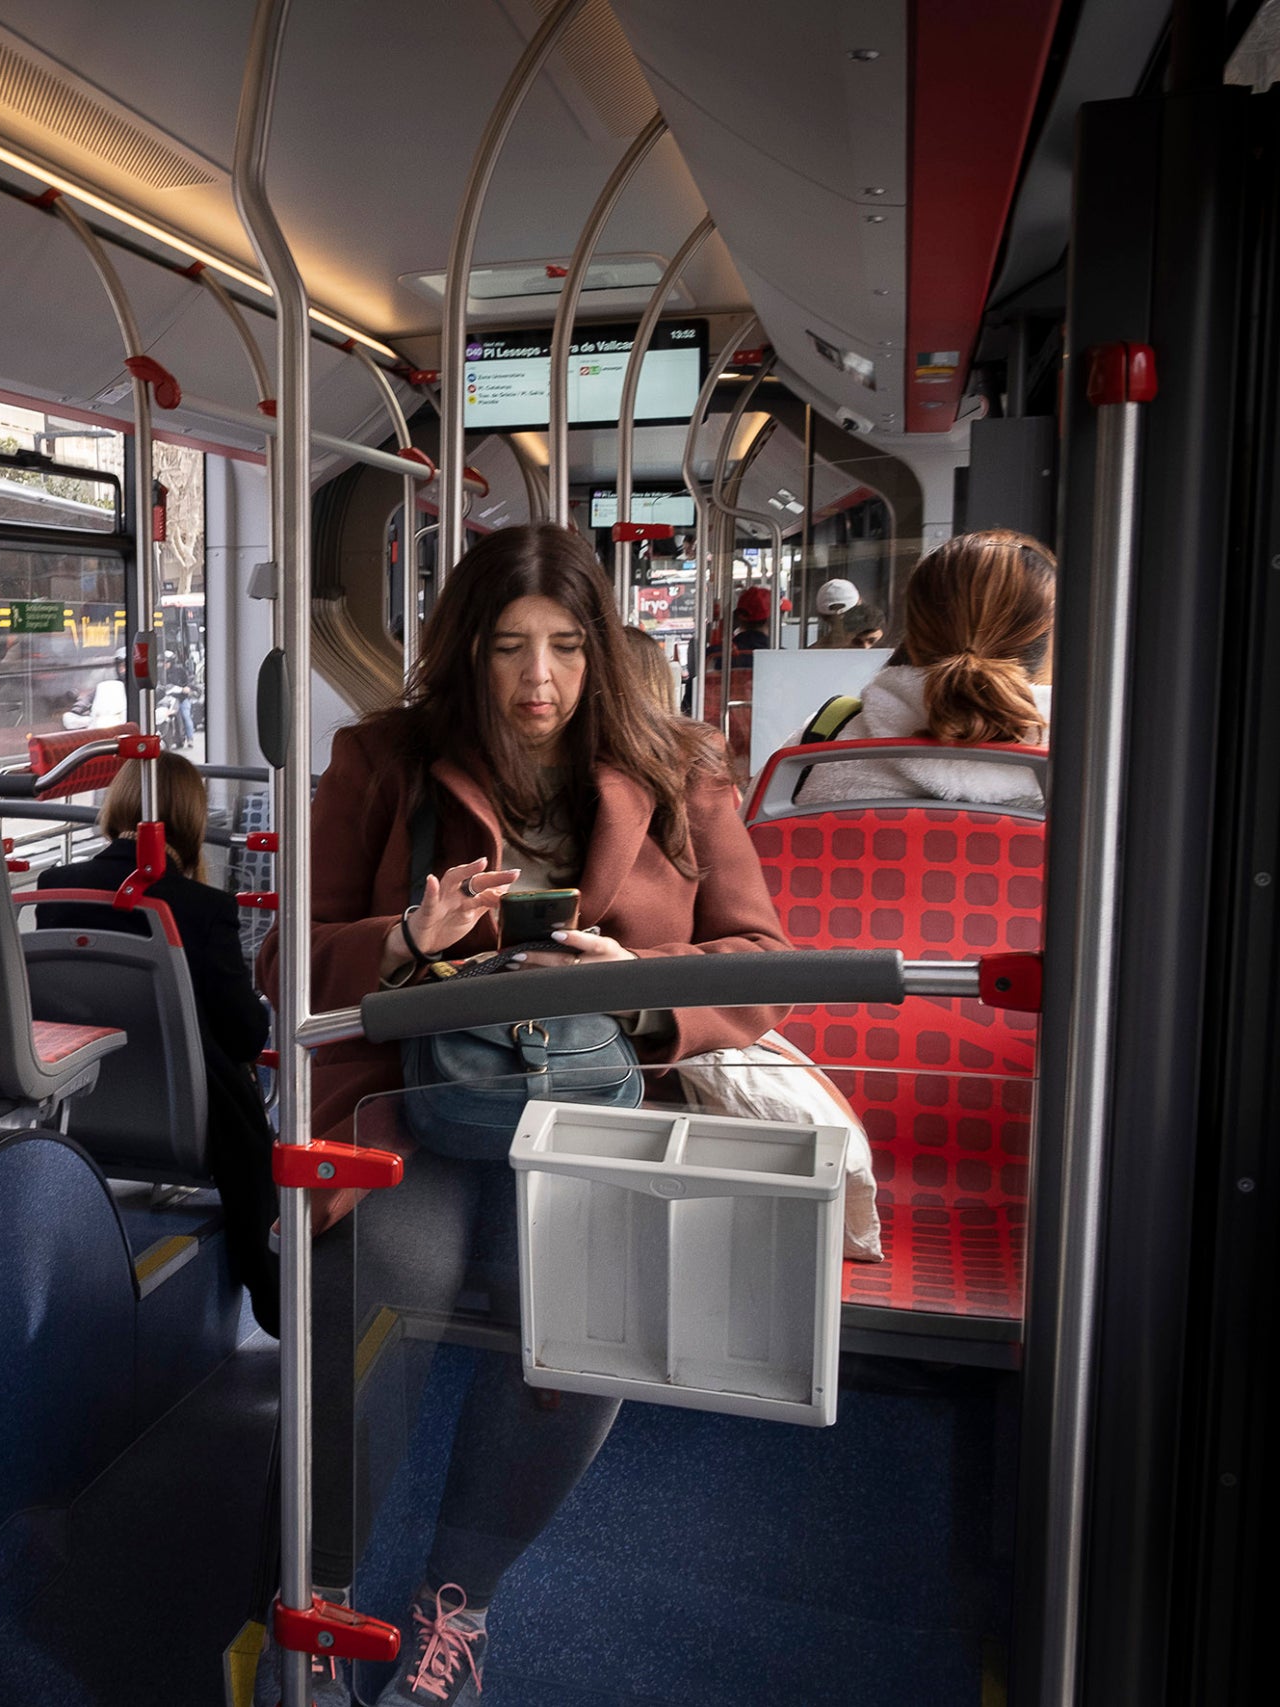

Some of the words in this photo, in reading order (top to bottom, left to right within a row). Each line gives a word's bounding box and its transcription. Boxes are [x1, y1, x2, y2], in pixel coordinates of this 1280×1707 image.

[670, 329, 696, 339] 13:52
[496, 346, 541, 358] Lesseps
[581, 342, 595, 353] de
[640, 597, 669, 615] iryo
